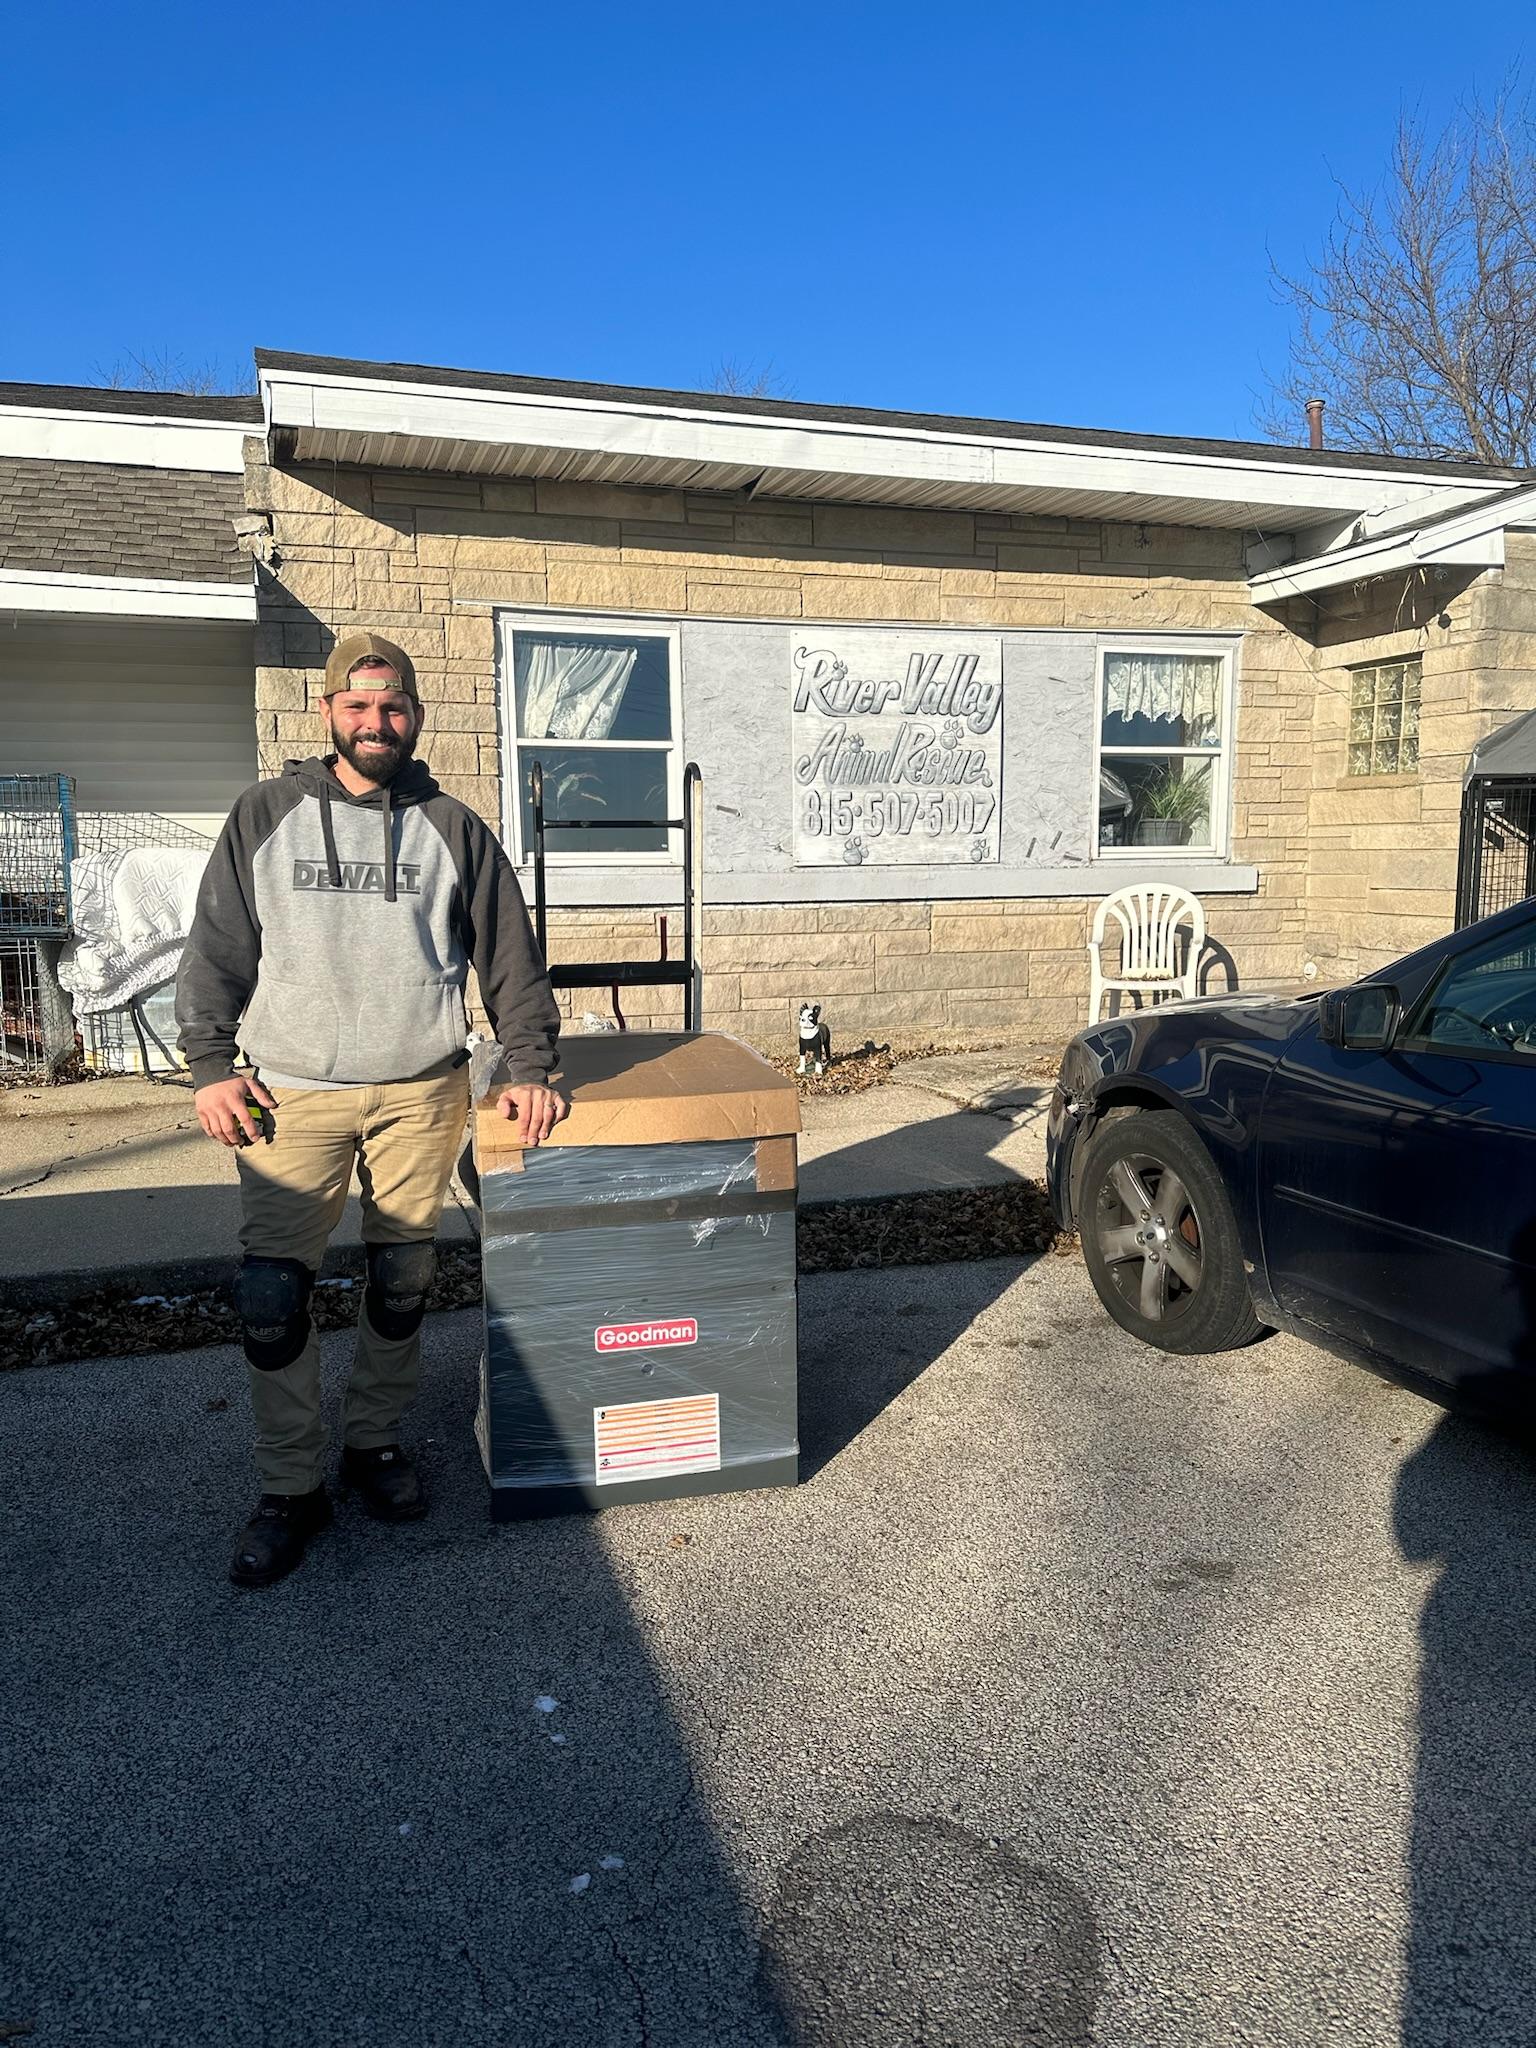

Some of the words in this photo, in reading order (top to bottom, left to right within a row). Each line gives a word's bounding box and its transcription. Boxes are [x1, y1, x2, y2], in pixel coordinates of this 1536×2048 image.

[794, 646, 900, 717] River
[901, 653, 1002, 734] Valley
[600, 1326, 693, 1345] Goodman
